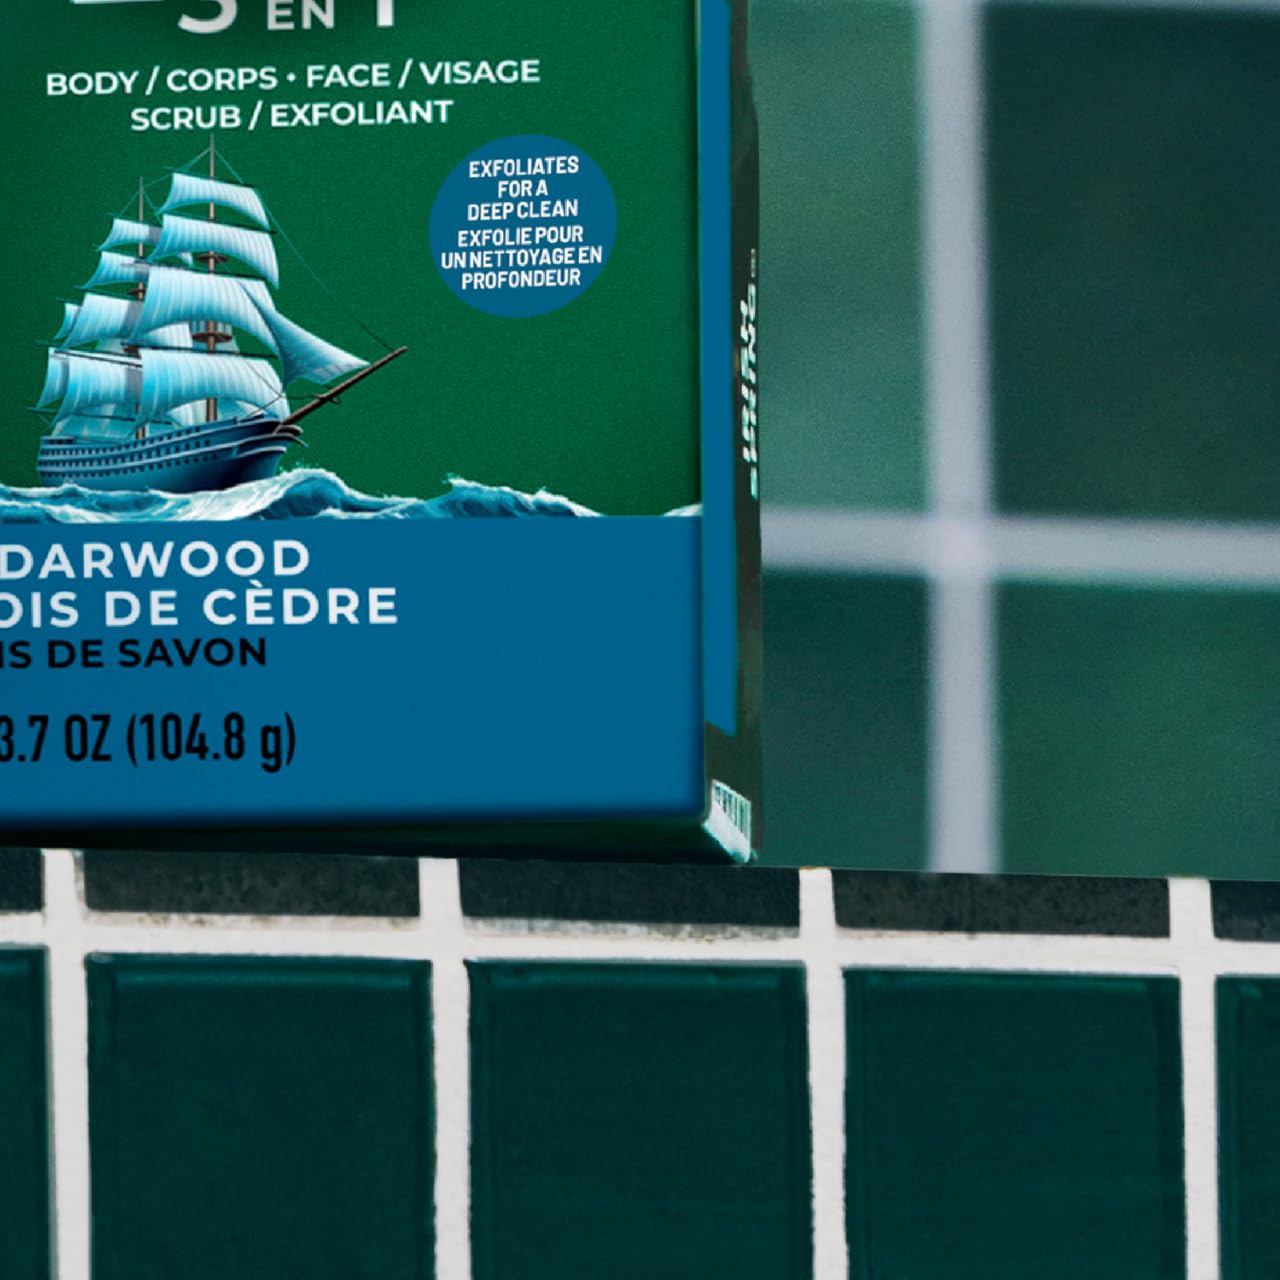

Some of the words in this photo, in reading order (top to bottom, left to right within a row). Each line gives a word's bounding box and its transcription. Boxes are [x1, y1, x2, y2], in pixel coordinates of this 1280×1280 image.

[46, 71, 139, 96] BODY
[166, 67, 278, 92] CORPS
[307, 63, 390, 88] FACE
[419, 59, 540, 85] VISAGE
[130, 105, 241, 131] SCRUB
[271, 99, 454, 127] EXFOLIANT
[469, 155, 579, 178] EXFOLIATES
[497, 179, 533, 199] FOR
[535, 179, 549, 197] A
[467, 201, 515, 221] DEEP
[516, 199, 579, 219] CLEAN
[457, 226, 533, 248] EXFOLIE
[534, 224, 584, 244] POUR
[441, 251, 467, 270] UN
[469, 244, 576, 269] NETTOYAGE
[578, 245, 603, 264] EN
[461, 266, 581, 290] PROFONDEUR
[105, 590, 178, 627] DE
[203, 579, 398, 626] CÈDRE
[47, 639, 104, 669] DE
[118, 637, 266, 668] SAVON
[64, 713, 112, 763] OZ
[126, 711, 245, 766] (104.8
[260, 713, 296, 774] g)
